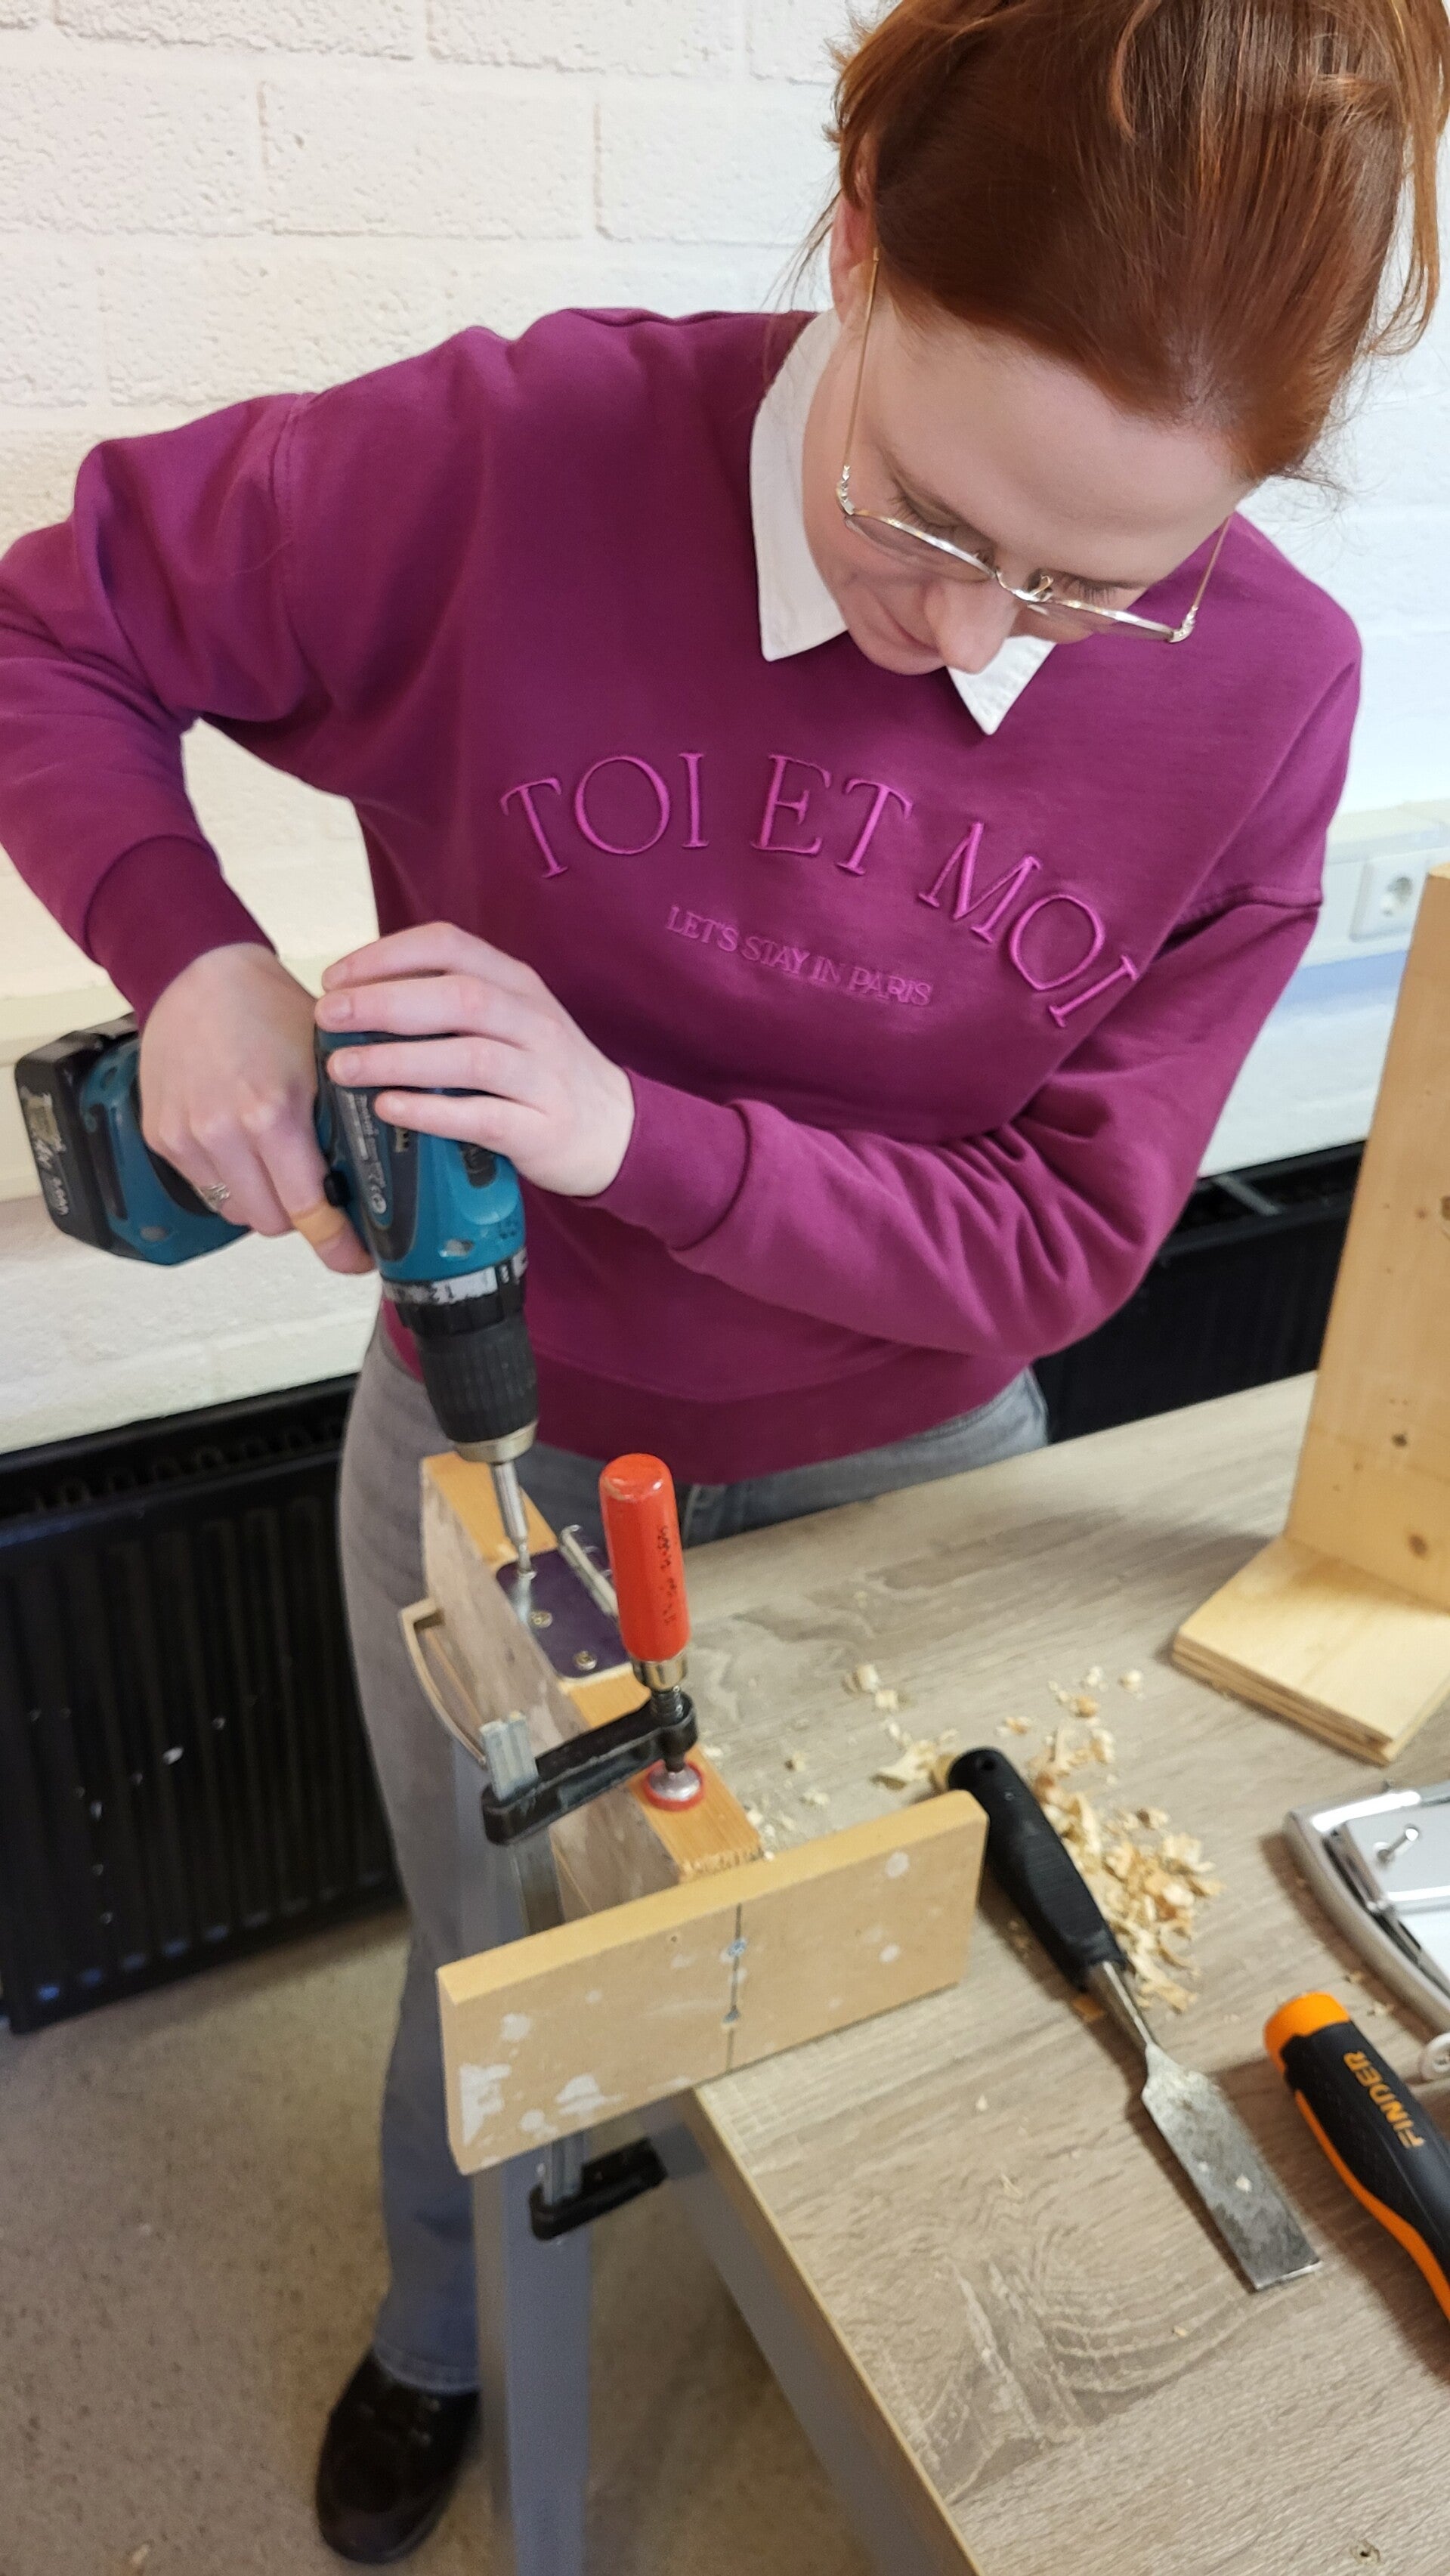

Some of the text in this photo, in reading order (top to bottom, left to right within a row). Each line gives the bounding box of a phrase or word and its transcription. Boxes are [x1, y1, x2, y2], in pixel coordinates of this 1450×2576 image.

[500, 753, 1138, 1027] TOI ET MOI
[666, 906, 932, 1006] LET'S STAY IN PARIS
[1343, 2051, 1425, 2149] FINDER
